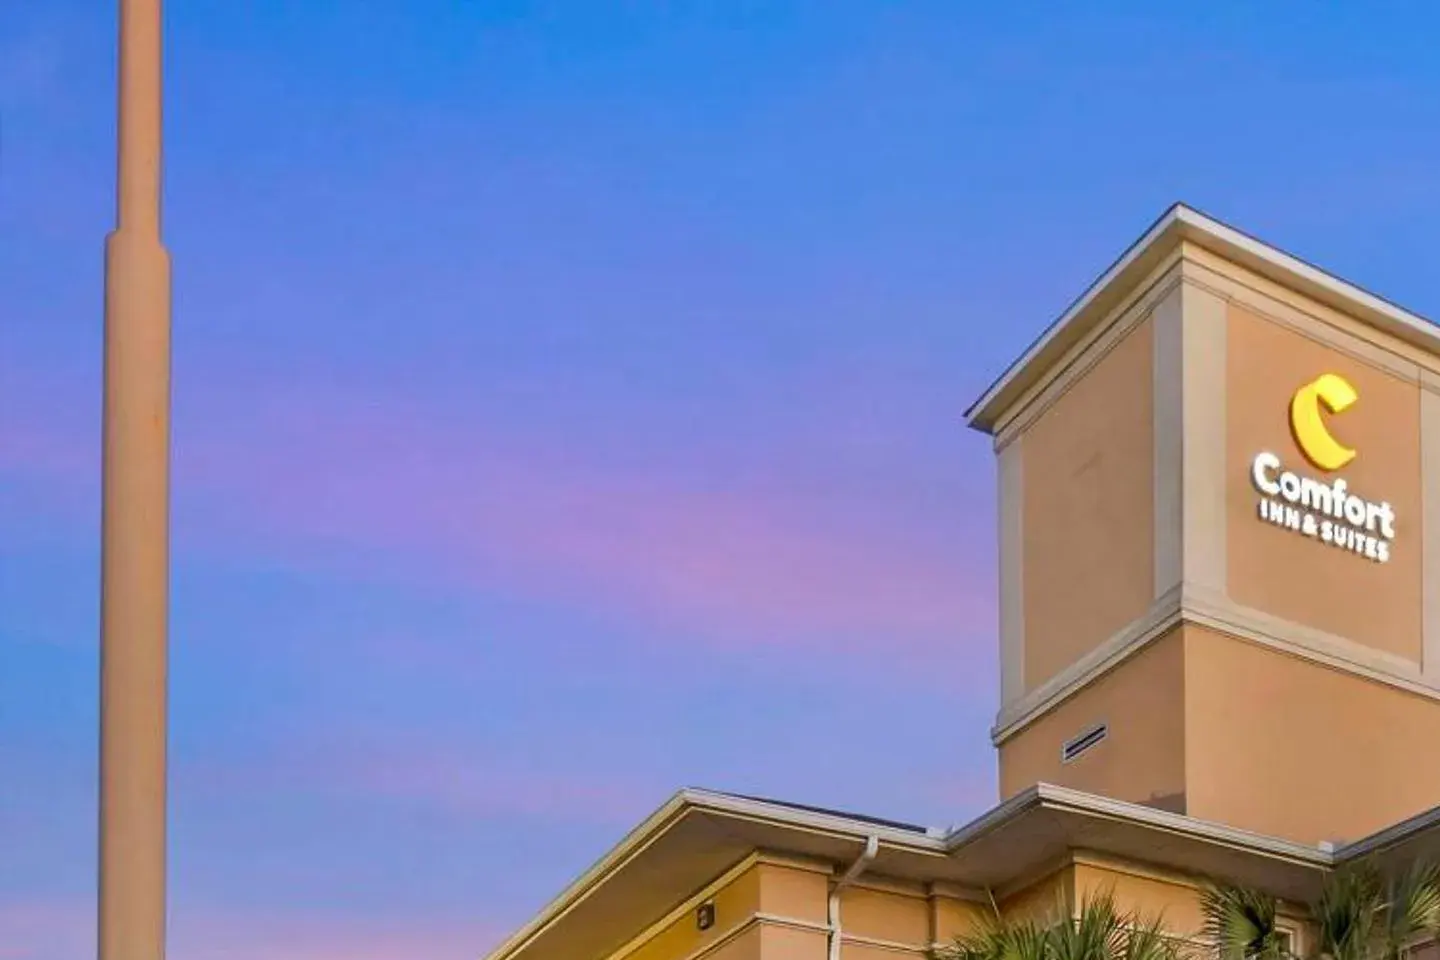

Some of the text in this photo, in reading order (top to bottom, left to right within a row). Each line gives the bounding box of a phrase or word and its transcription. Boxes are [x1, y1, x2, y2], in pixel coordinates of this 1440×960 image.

[1252, 452, 1395, 539] Comfort
[1259, 498, 1389, 562] INN & SUITES
